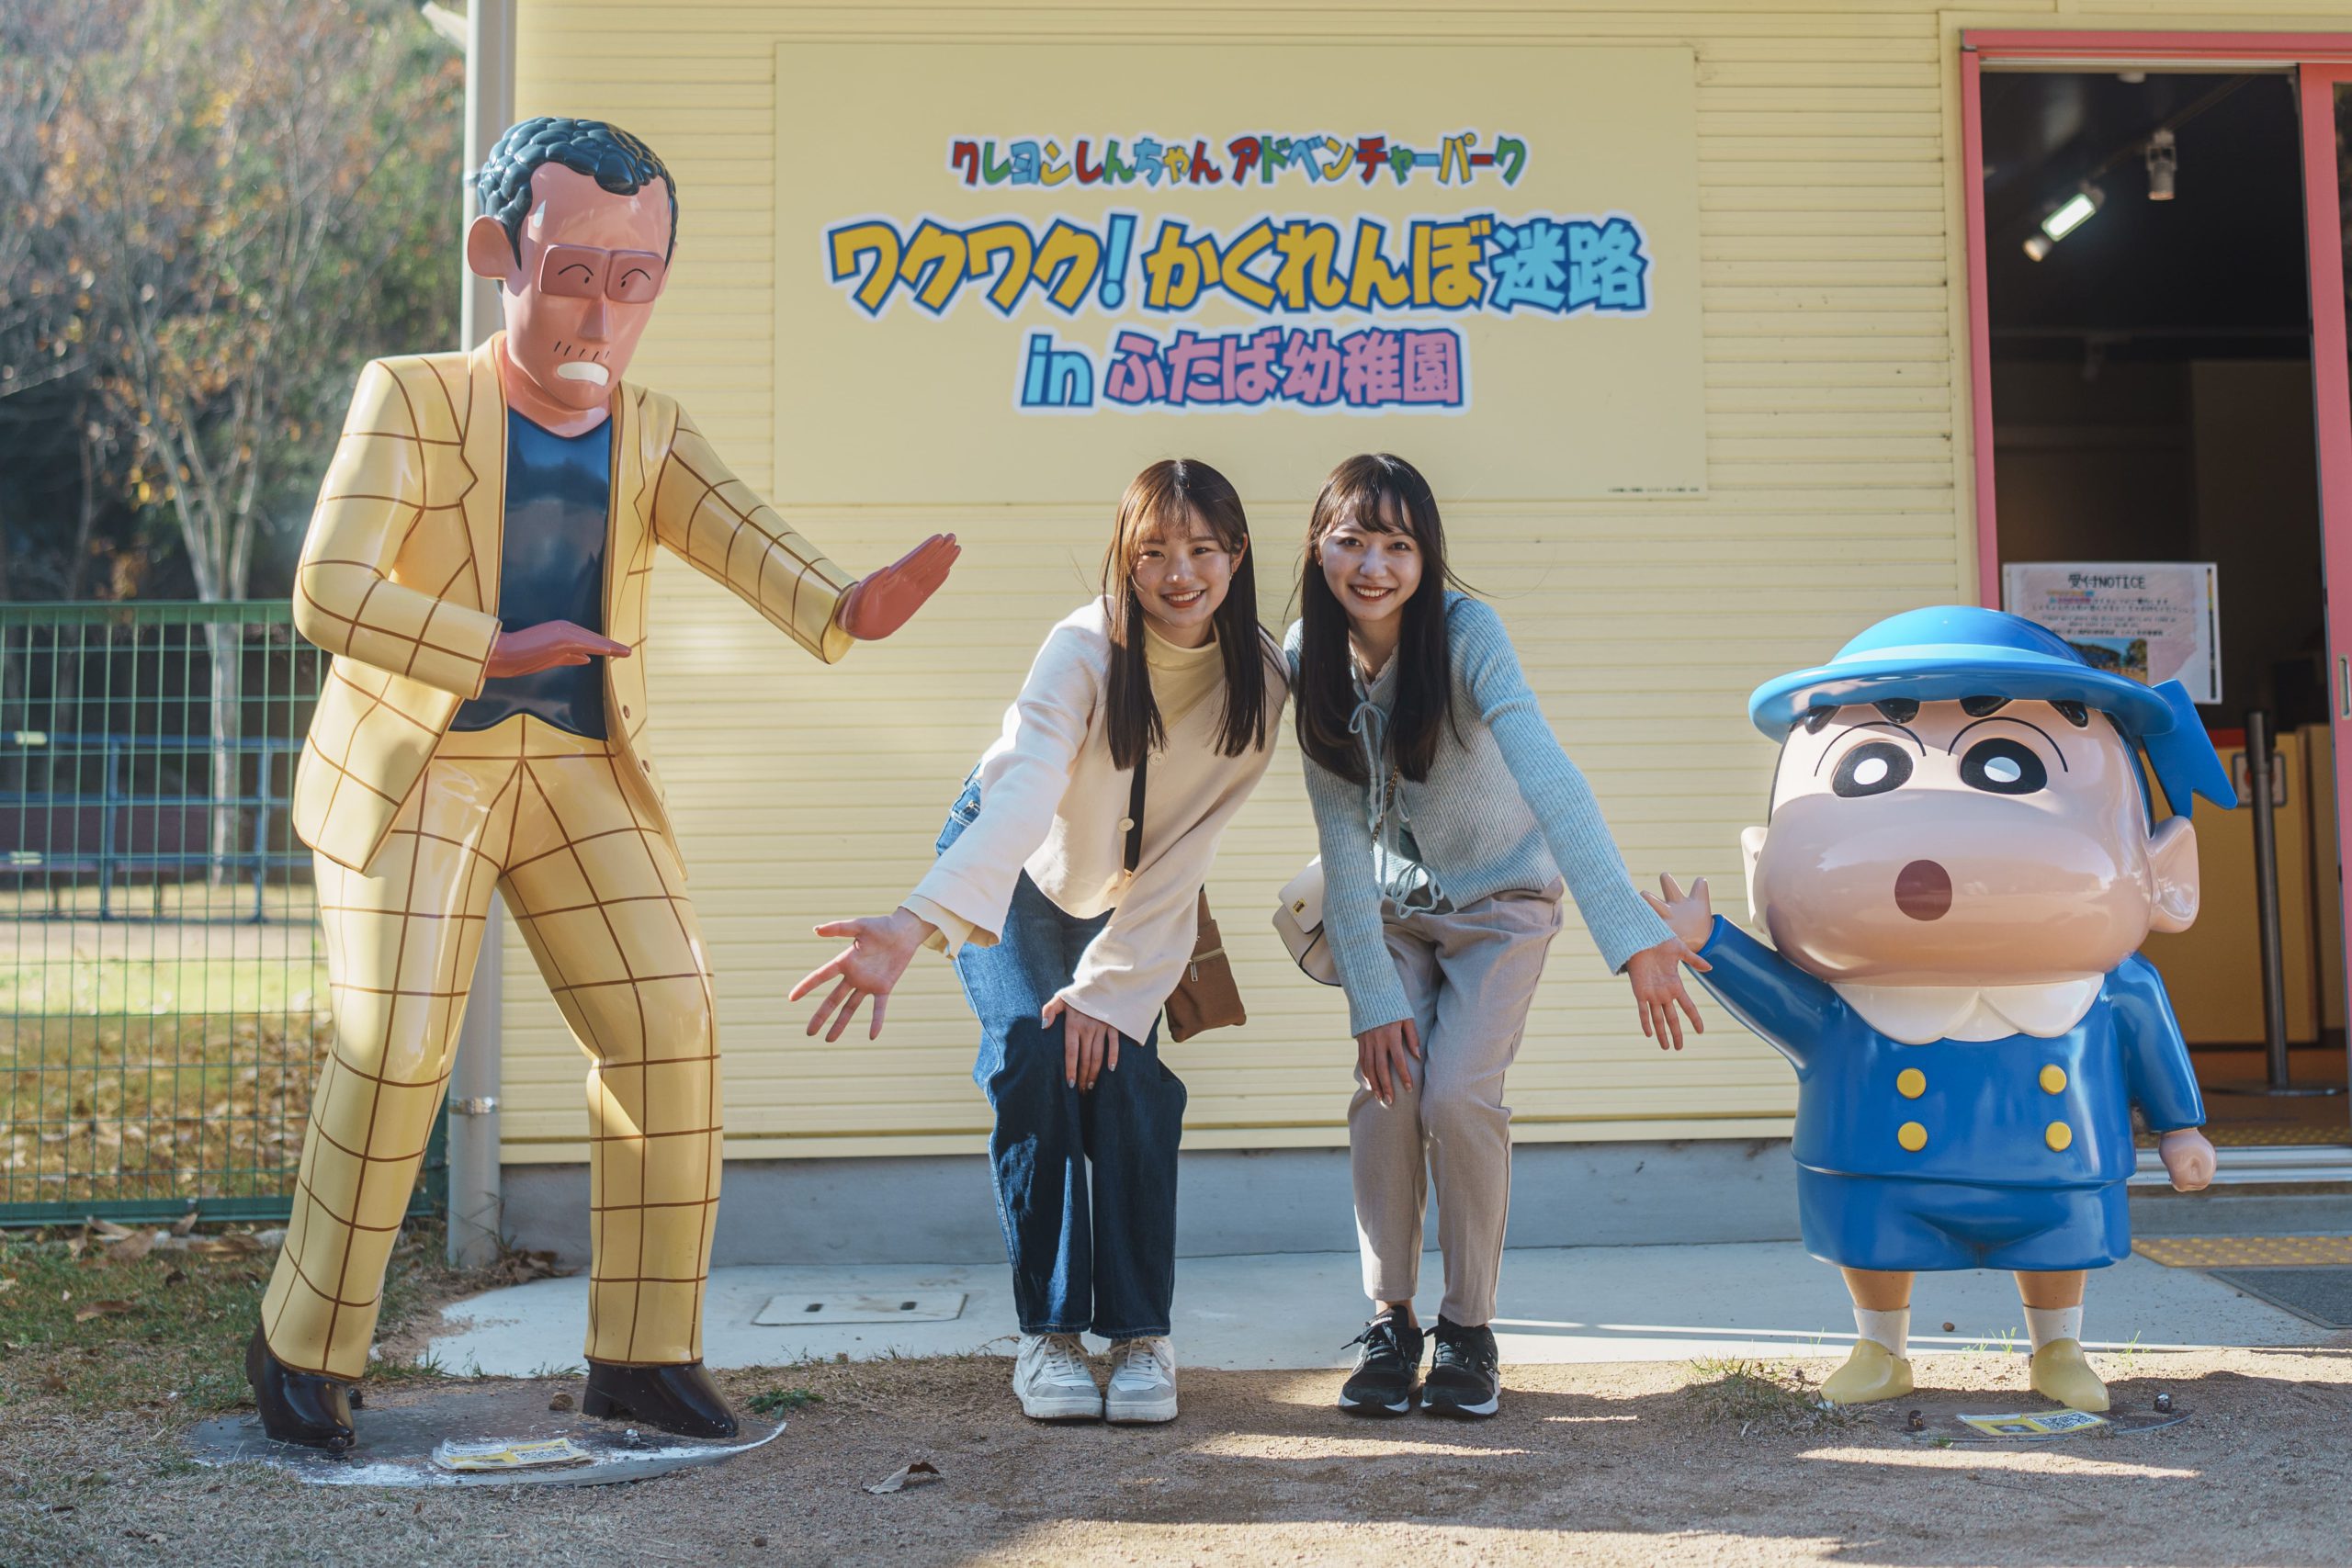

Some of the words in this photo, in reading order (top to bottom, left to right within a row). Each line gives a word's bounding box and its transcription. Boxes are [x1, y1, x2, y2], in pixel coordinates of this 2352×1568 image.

[1021, 333, 1093, 407] in
[1104, 326, 1464, 407] ふたば幼稚園
